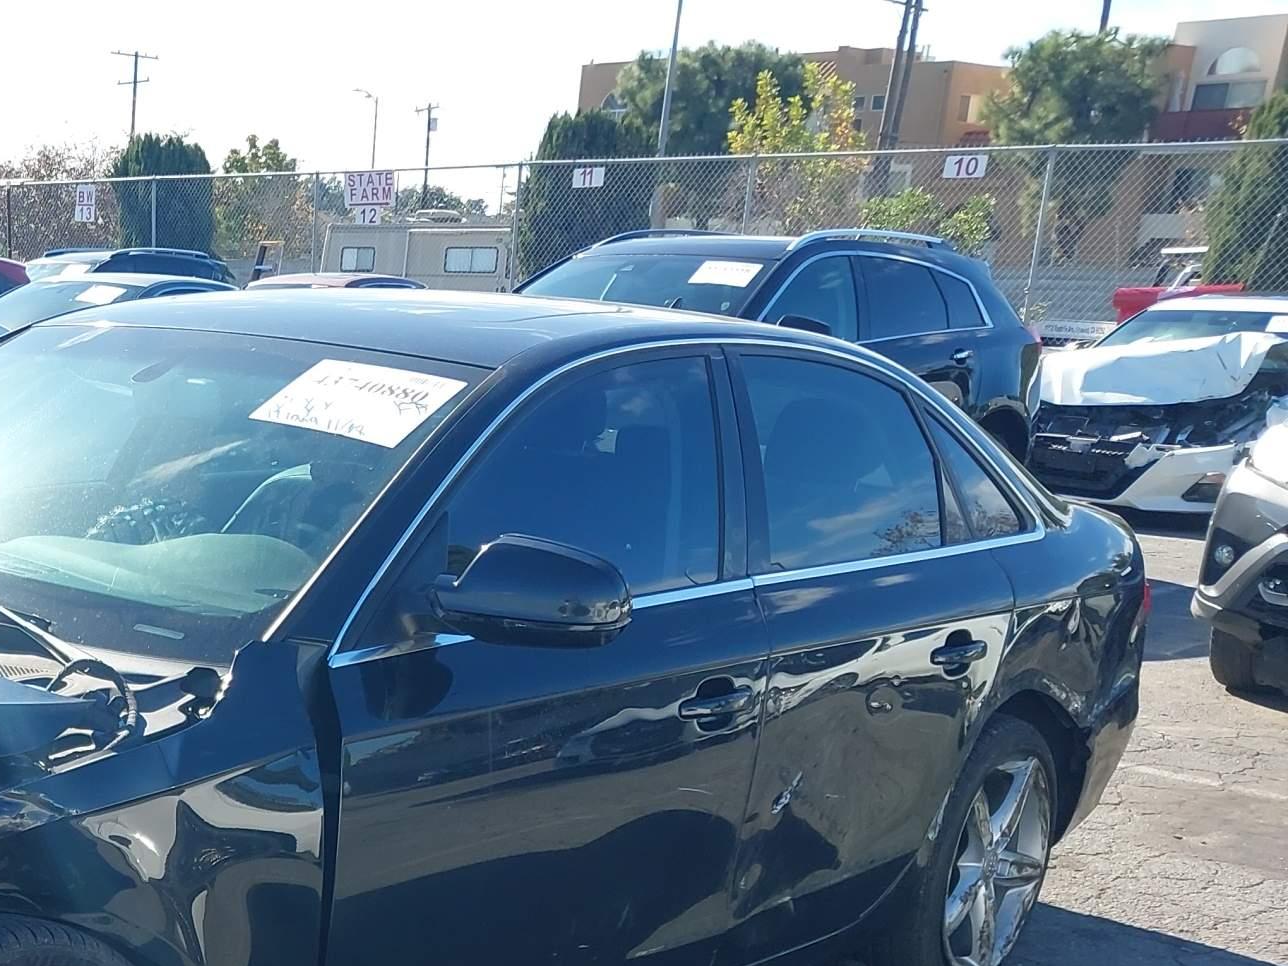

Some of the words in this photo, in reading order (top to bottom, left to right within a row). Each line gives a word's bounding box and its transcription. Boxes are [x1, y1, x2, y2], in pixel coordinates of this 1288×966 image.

[954, 157, 978, 176] 10
[347, 172, 393, 188] STATE
[580, 167, 593, 187] 11
[78, 191, 93, 203] BW
[350, 187, 392, 202] FARM
[79, 206, 92, 220] 13
[360, 208, 377, 223] 12
